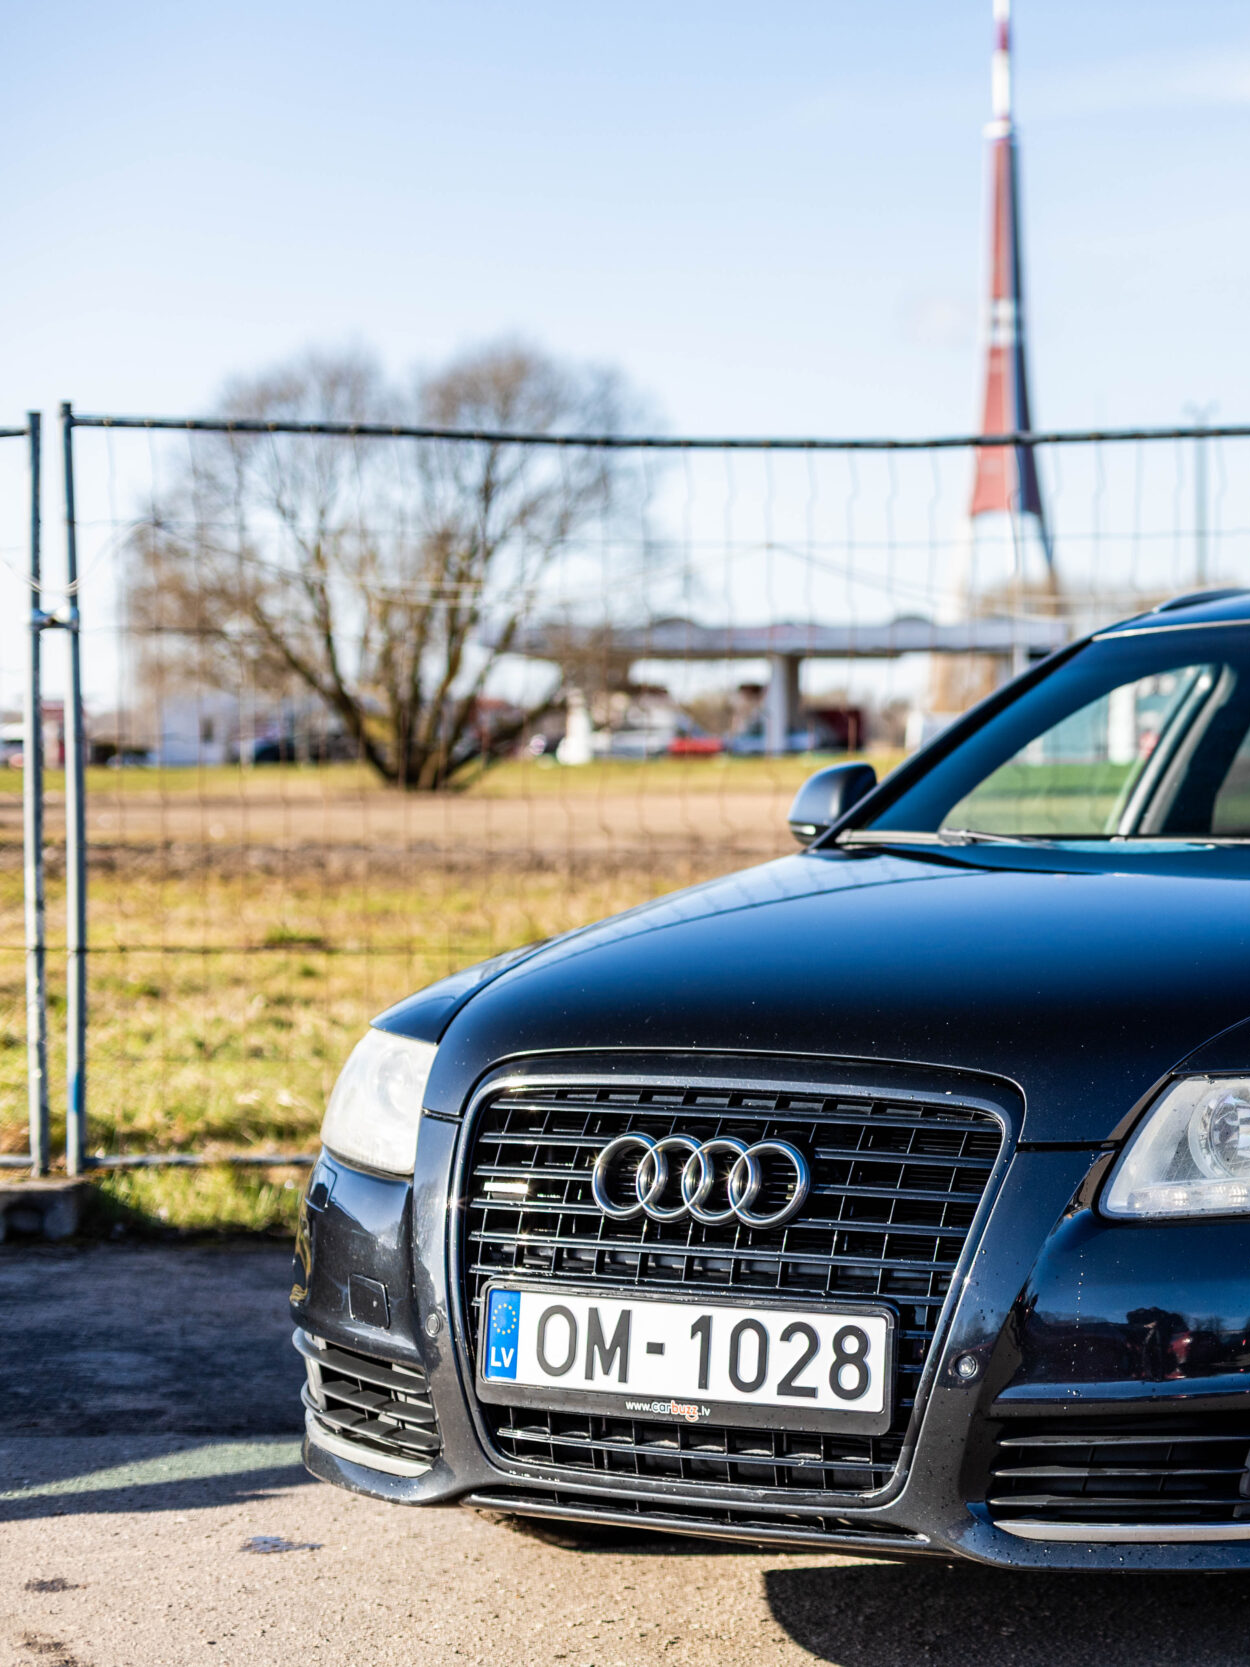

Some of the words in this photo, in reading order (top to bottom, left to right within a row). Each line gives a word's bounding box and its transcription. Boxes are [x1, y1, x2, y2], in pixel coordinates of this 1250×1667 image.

[490, 1346, 515, 1368] LV
[536, 1304, 871, 1401] OM-1028
[625, 1399, 711, 1418] www.carbuzz.lv
